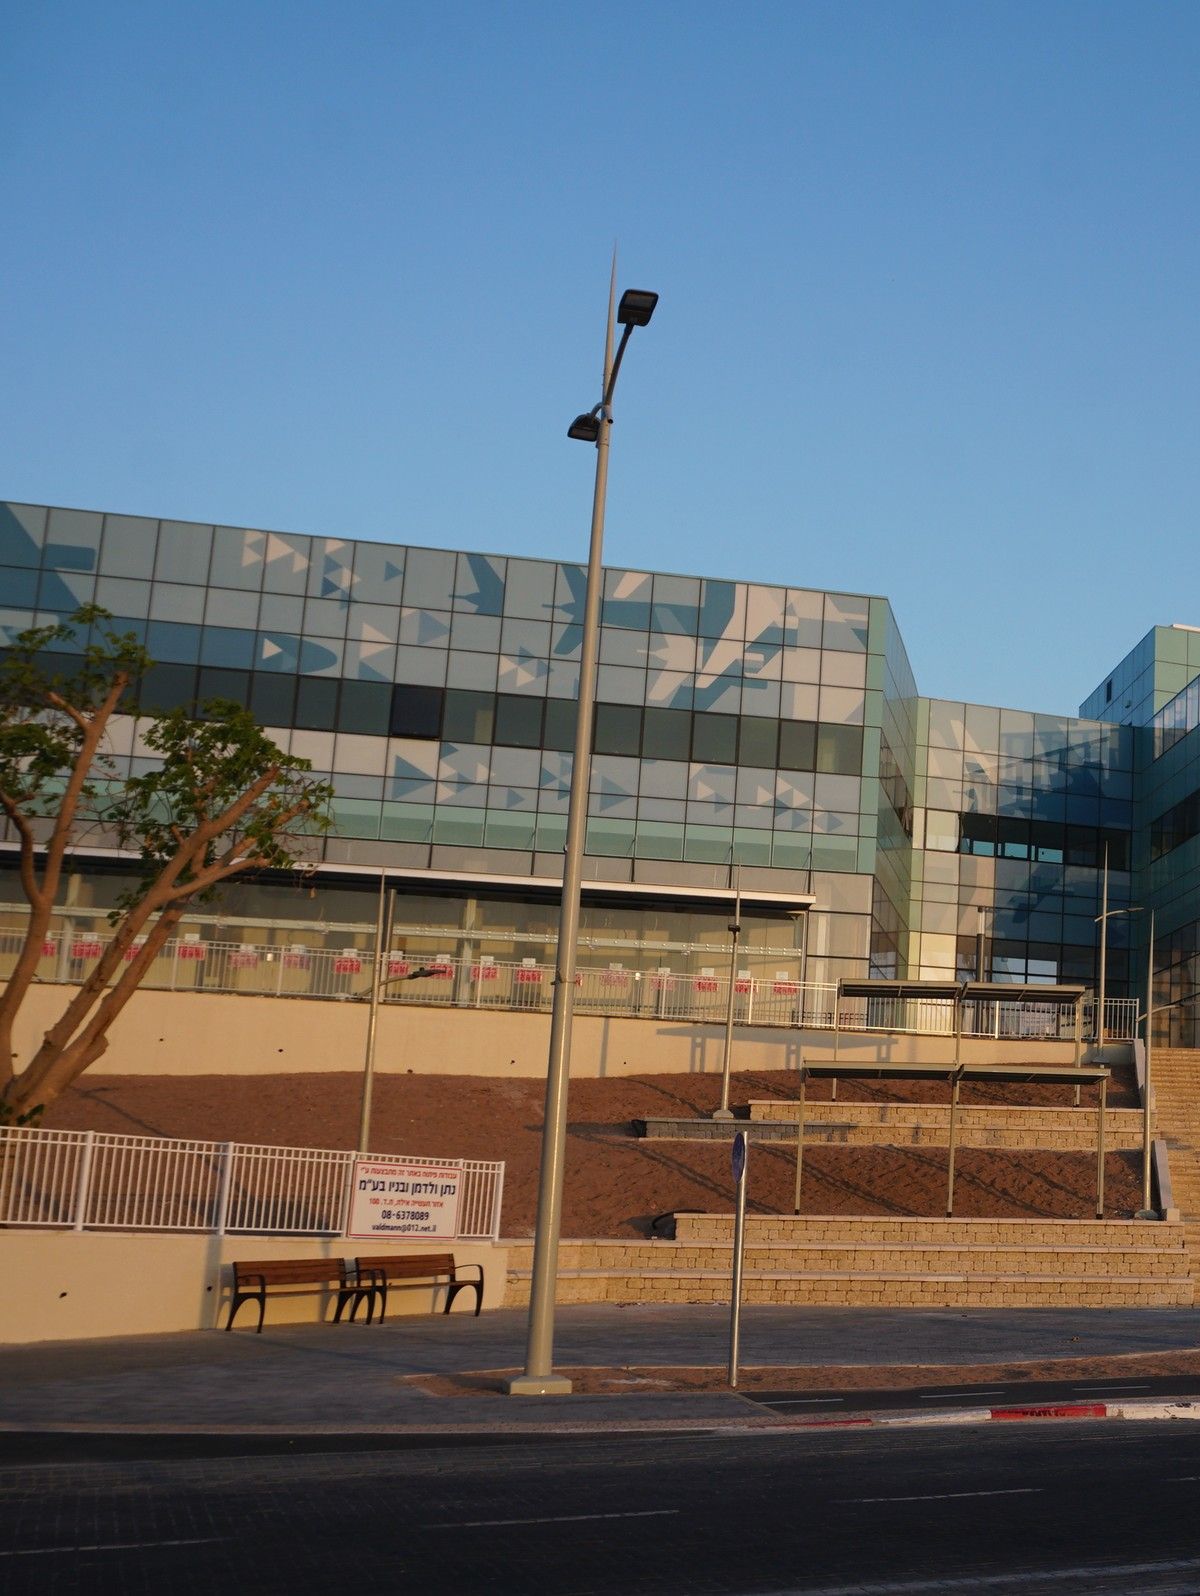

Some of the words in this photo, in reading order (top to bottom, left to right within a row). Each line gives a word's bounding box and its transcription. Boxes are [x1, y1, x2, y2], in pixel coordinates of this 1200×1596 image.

[388, 1181, 409, 1193] ובניו
[411, 1182, 438, 1196] ולדמן
[440, 1184, 456, 1197] נתן
[381, 1210, 429, 1221] 08-6378089
[372, 1223, 437, 1233] valdmann@012.net.il
